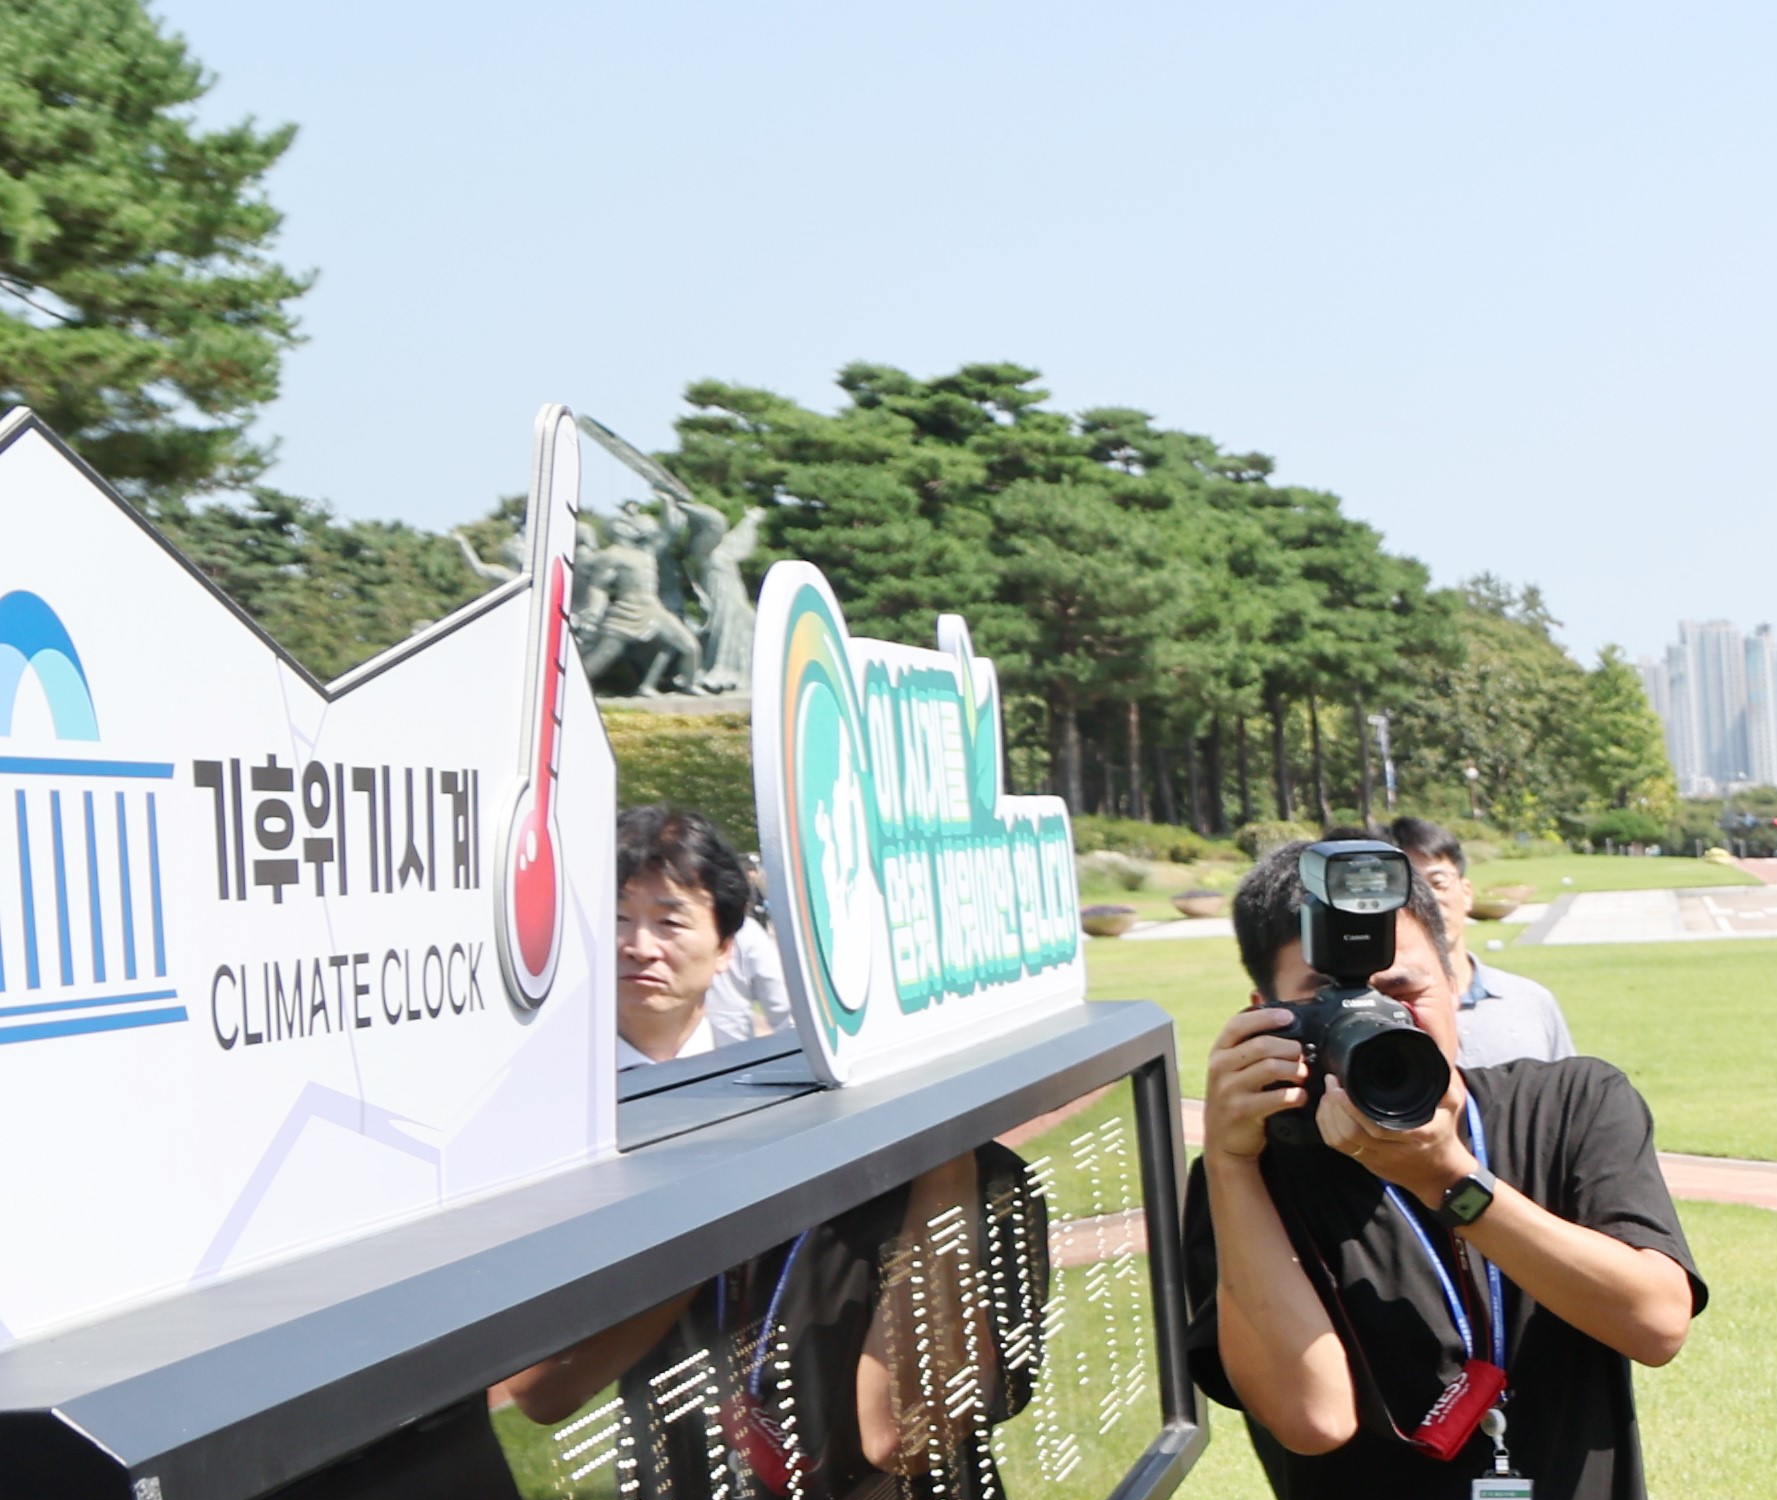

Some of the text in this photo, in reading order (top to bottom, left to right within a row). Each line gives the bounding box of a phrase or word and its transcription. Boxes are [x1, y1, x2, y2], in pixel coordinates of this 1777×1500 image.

[193, 752, 481, 904] 기후위기시계
[210, 942, 486, 1052] CLIMATE CLOCK
